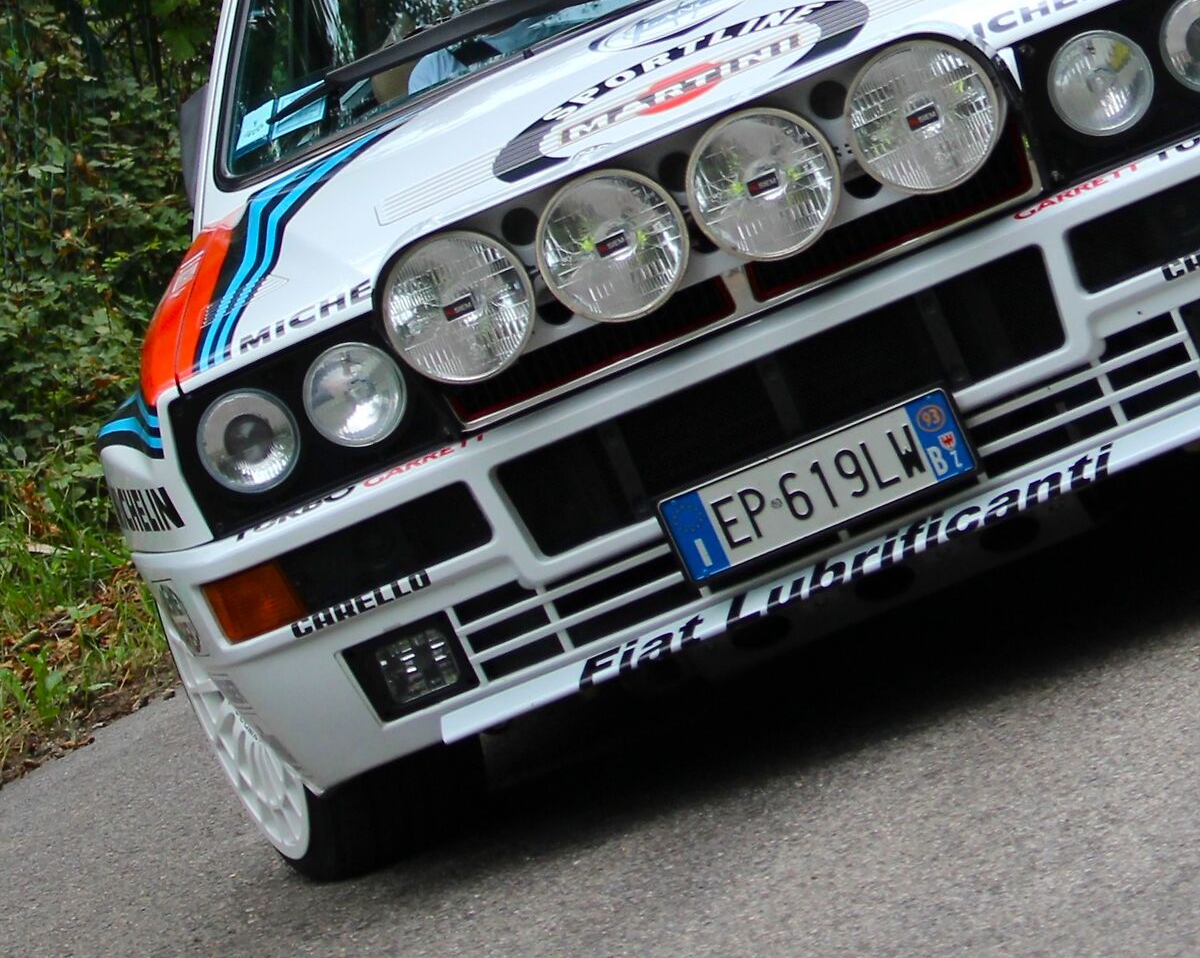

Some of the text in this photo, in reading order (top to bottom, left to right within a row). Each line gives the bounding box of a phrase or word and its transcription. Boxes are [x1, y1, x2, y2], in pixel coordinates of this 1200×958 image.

[542, 2, 826, 121] SPORTLINE
[568, 34, 801, 141] MARTINI
[1014, 163, 1139, 220] GARRETT
[240, 279, 372, 354] MICHE
[291, 569, 431, 638] CARELLO
[579, 444, 1114, 690] Fiat Lubrificanti
